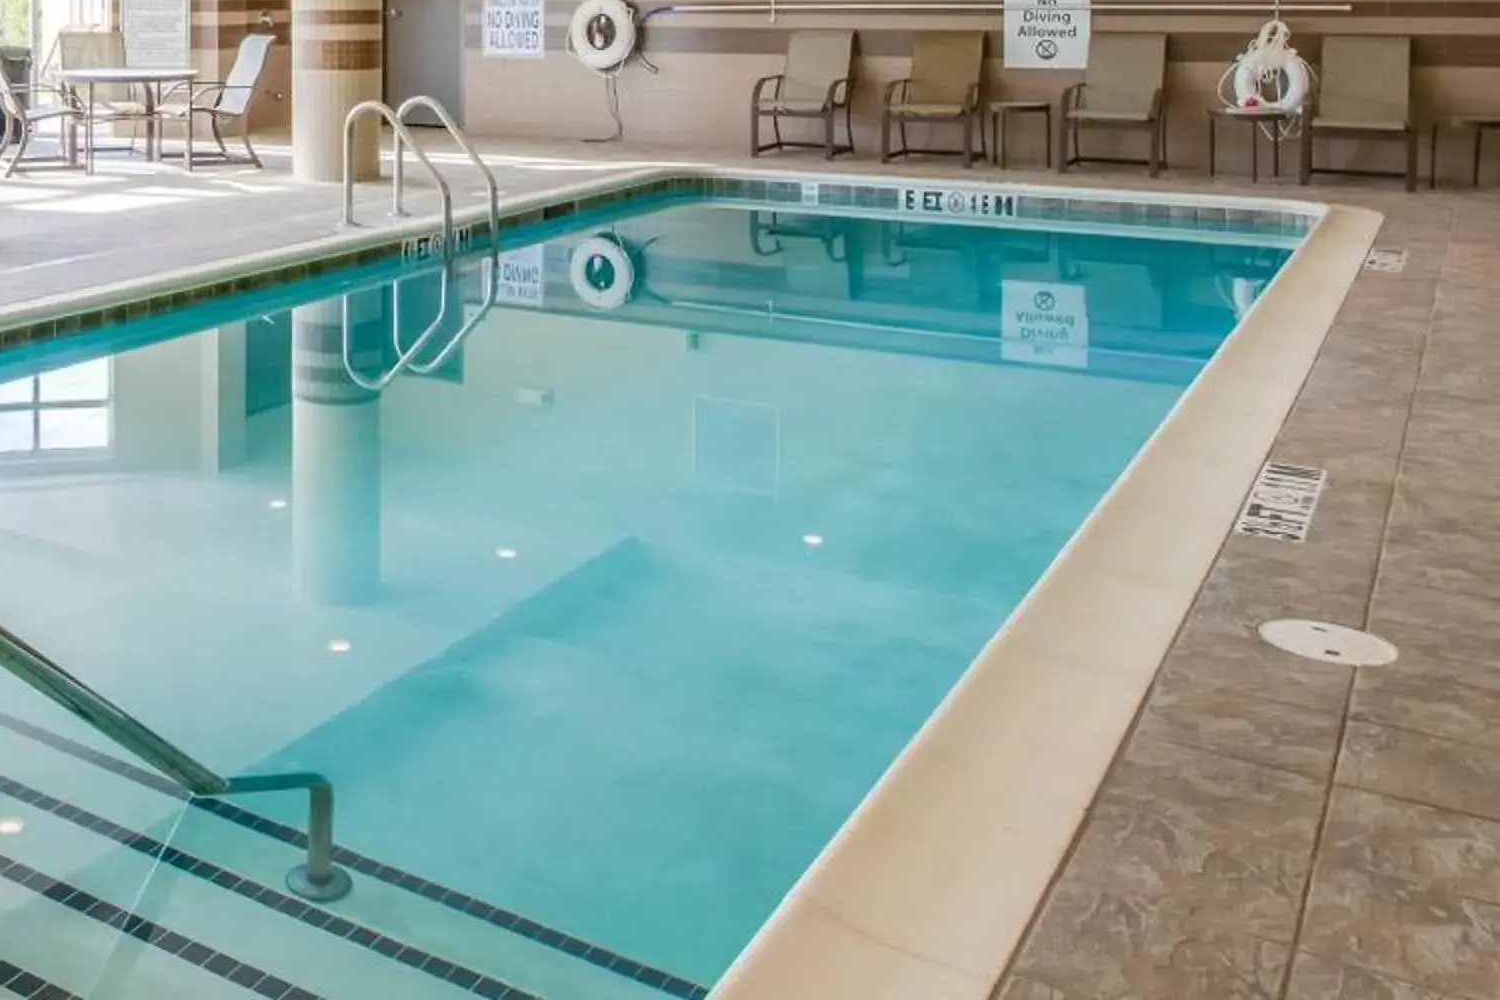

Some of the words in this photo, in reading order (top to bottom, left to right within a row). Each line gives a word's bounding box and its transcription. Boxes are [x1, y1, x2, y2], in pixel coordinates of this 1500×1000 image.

[487, 11, 503, 29] NO
[504, 11, 539, 29] DIVING
[1023, 8, 1071, 25] Diving
[488, 30, 539, 49] ALLOWED
[1017, 26, 1077, 38] Allowed
